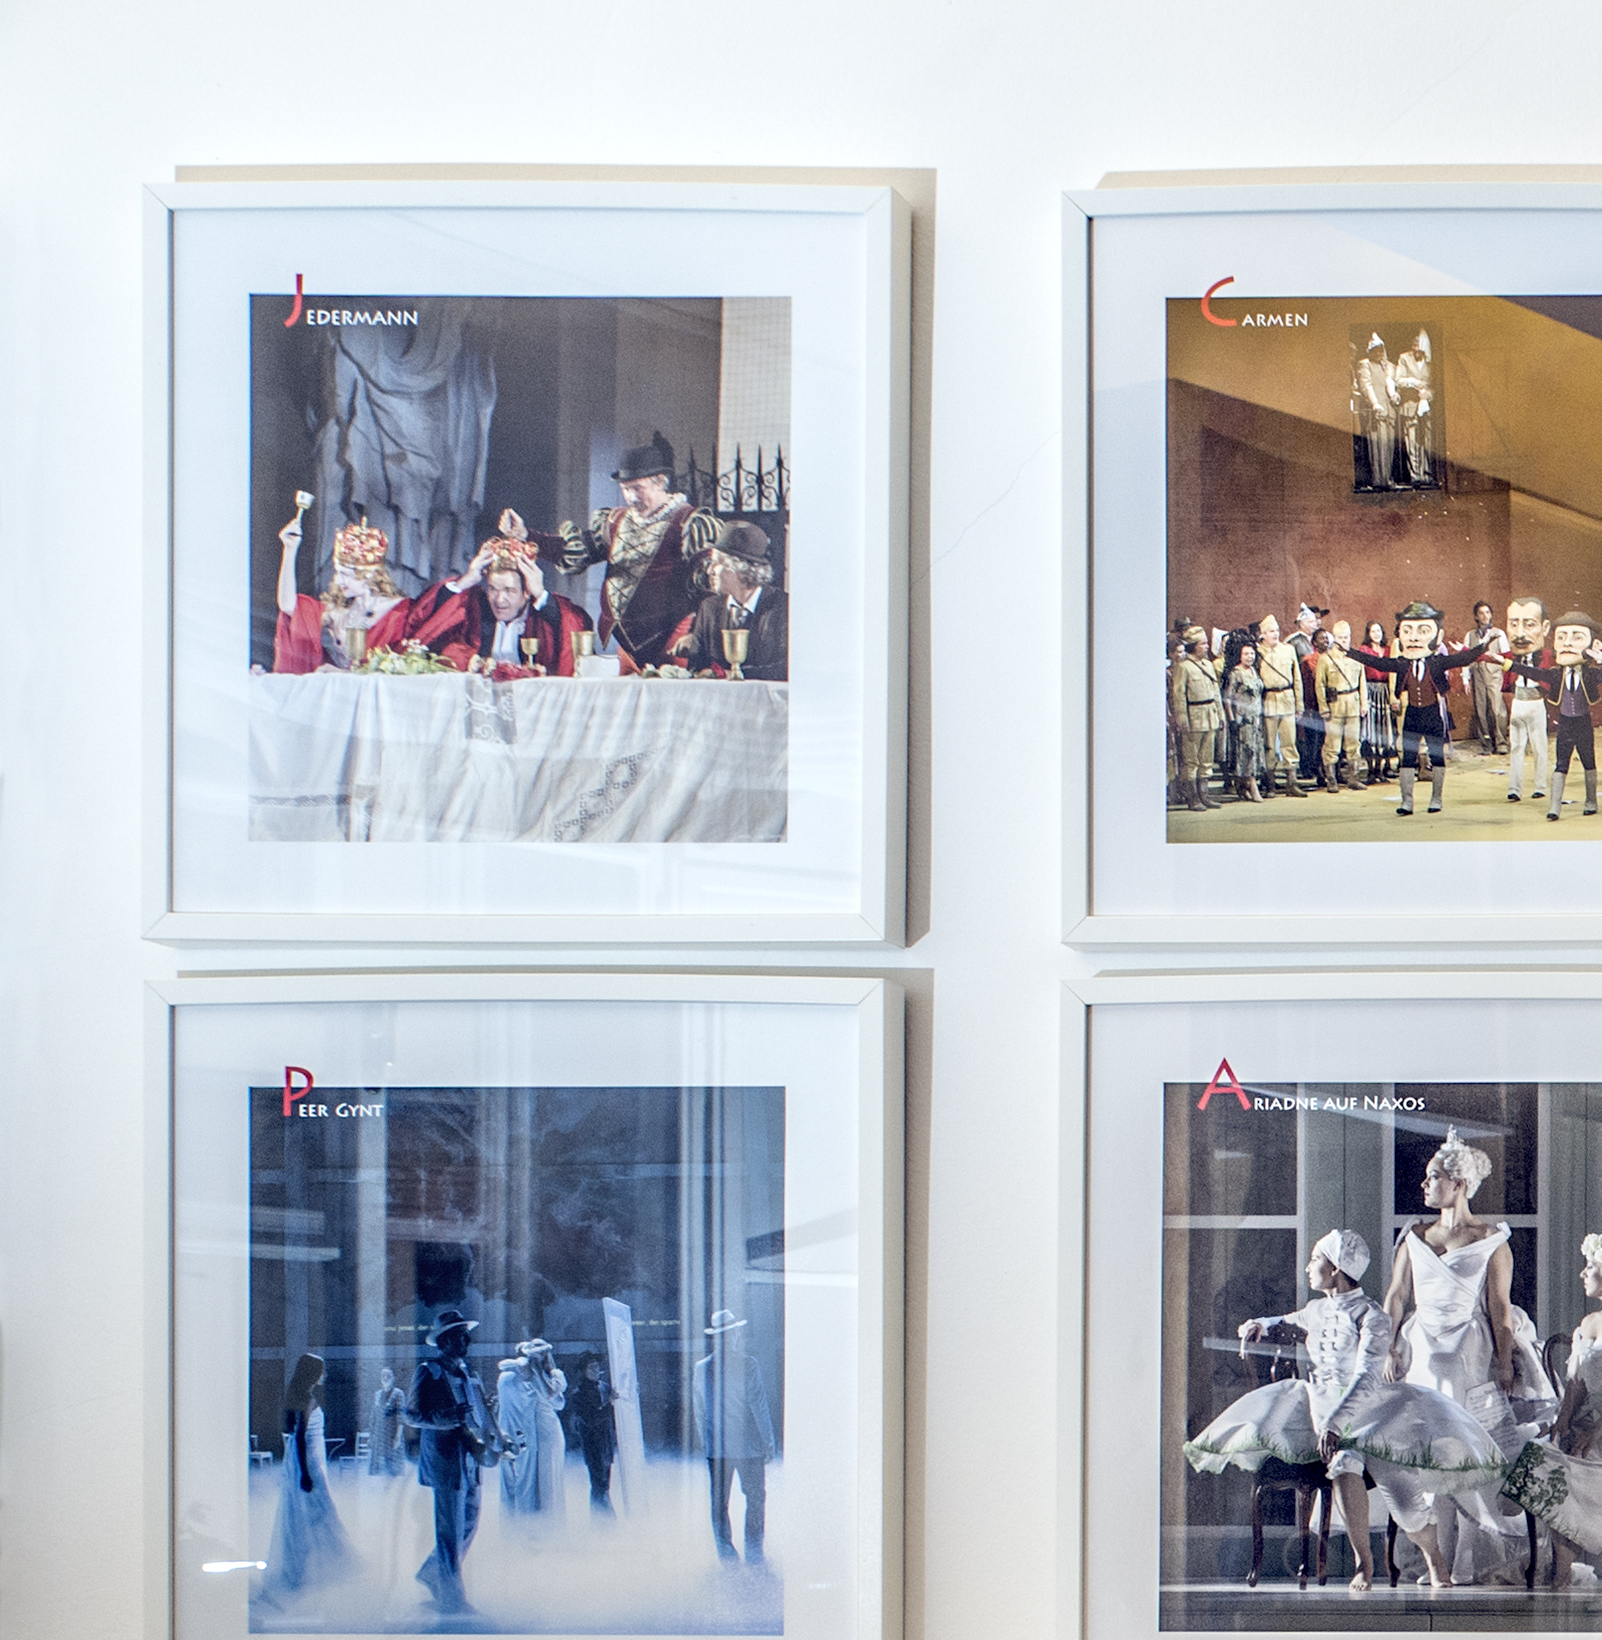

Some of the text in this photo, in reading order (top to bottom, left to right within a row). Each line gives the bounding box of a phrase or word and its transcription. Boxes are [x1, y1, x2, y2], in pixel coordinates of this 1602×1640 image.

[283, 273, 418, 328] JEDERMANN
[1200, 275, 1309, 328] CARMEN
[283, 1066, 385, 1118] PEER GYNT
[1197, 1057, 1426, 1111] ARIADNE AUF NAXOS
